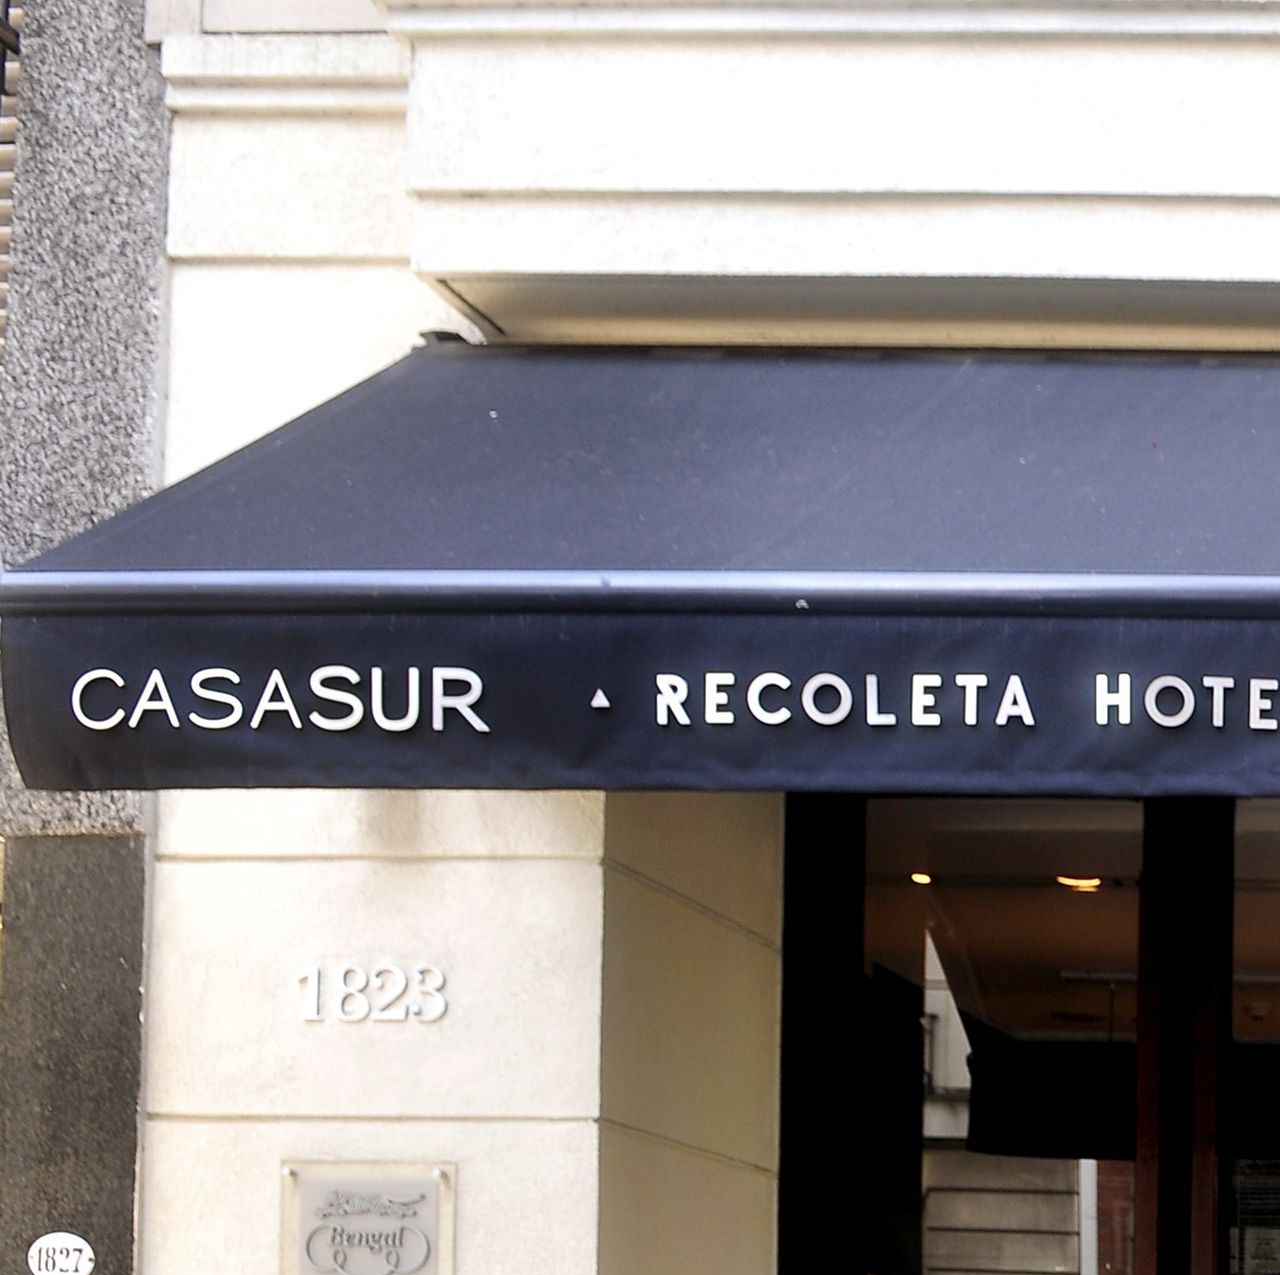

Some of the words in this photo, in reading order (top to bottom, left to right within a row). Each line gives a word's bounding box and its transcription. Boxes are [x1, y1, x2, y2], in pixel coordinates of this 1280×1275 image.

[71, 664, 491, 732] CASASUR
[655, 671, 1036, 727] RECOLETA
[298, 964, 449, 1024] 1823
[35, 1246, 85, 1274] 1827
[330, 1225, 406, 1253] Bengal
